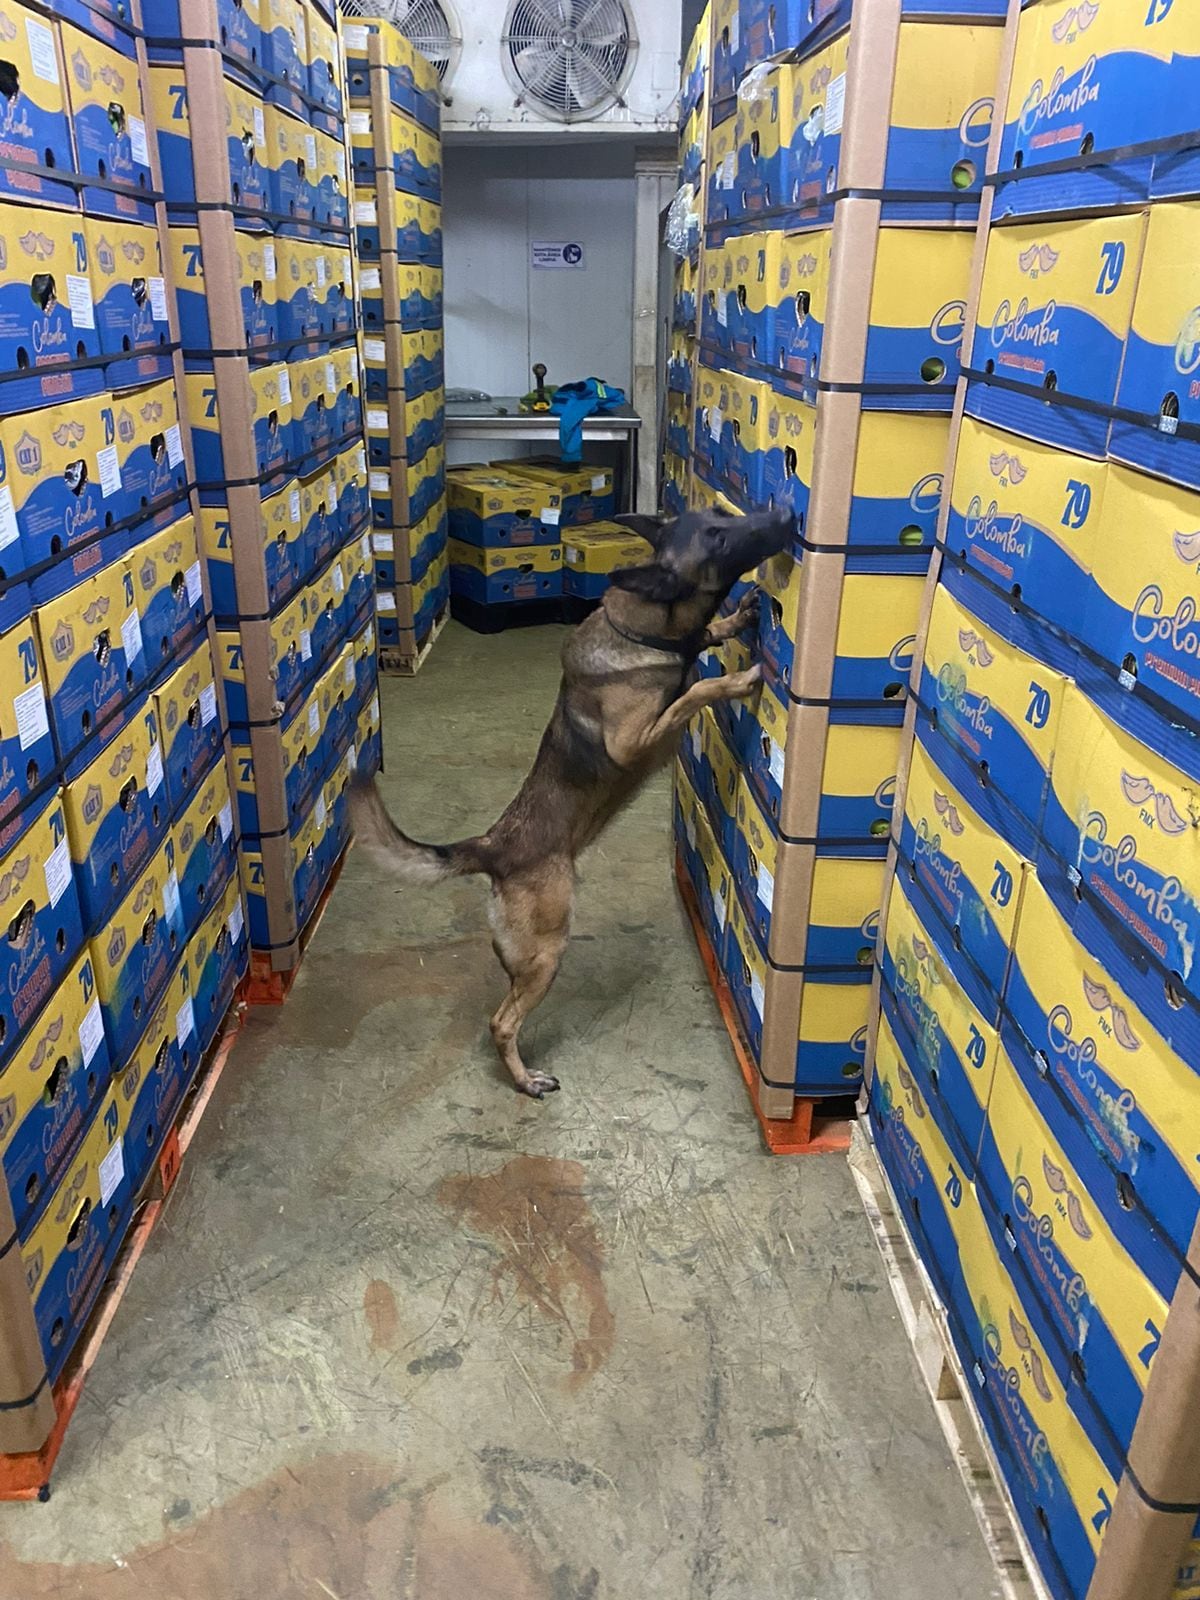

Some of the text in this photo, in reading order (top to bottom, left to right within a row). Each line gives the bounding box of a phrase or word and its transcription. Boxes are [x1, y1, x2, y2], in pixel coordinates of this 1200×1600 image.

[168, 85, 188, 119] 7
[1019, 54, 1100, 135] Colomba
[72, 232, 87, 273] 79
[182, 245, 204, 277] 7
[1095, 241, 1125, 295] 79
[33, 317, 67, 353] Colomba
[991, 296, 1060, 348] Colomba
[202, 389, 217, 418] 7
[101, 408, 115, 446] 79
[65, 496, 97, 537] Colomba
[965, 495, 1026, 558] Colomba
[1060, 479, 1091, 530] 79
[214, 521, 231, 549] 7
[123, 571, 134, 608] 79
[1132, 584, 1200, 658] Colo
[18, 635, 38, 684] 79
[226, 644, 243, 671] 7
[93, 662, 120, 708] Colomba
[937, 662, 993, 740] Colomba
[1024, 680, 1051, 729] 79
[145, 709, 157, 747] 79
[238, 758, 255, 783] 7
[49, 807, 65, 849] 79
[1138, 808, 1156, 830] FMX
[249, 861, 264, 885] 7
[915, 817, 964, 900] Colomba
[1081, 811, 1188, 943] Colomba
[990, 860, 1013, 908] 79
[9, 928, 46, 995] Colomba
[79, 958, 94, 1005] 79
[966, 1022, 987, 1069] 79
[1098, 1015, 1113, 1039] FMX
[104, 1099, 118, 1145] 79
[944, 1162, 963, 1209] 79
[1138, 1318, 1162, 1371] 7
[1091, 1487, 1112, 1535] 7
